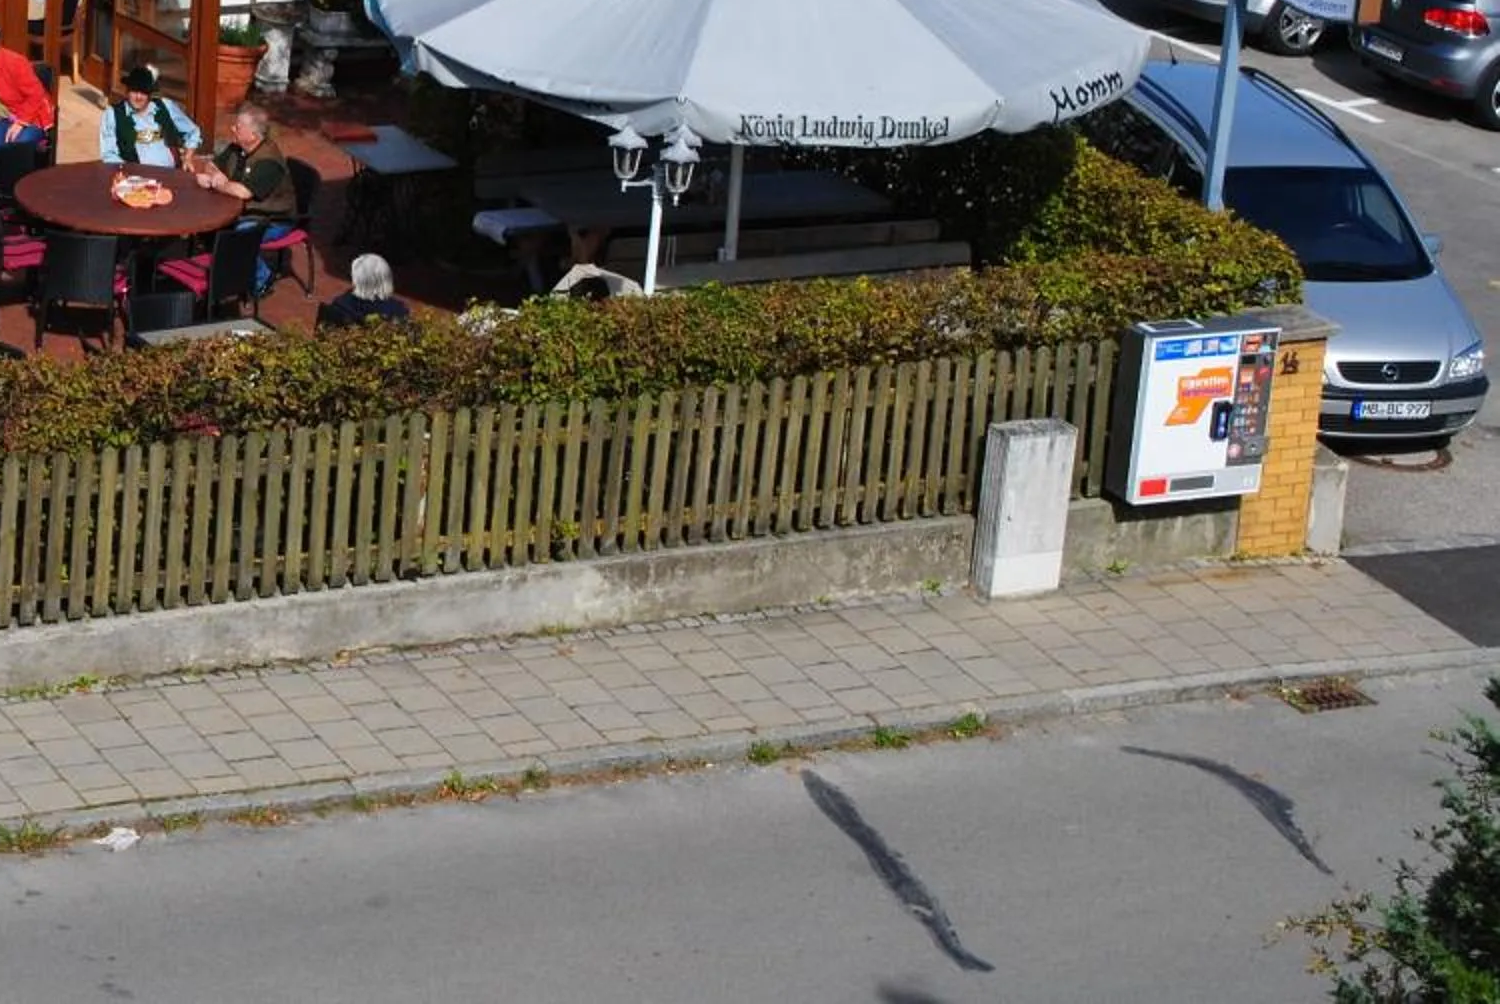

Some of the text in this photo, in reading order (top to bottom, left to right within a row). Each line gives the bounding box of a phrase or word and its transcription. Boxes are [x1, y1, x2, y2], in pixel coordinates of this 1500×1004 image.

[1049, 71, 1124, 125] Momm
[739, 113, 950, 145] König Ludwig Dunkel
